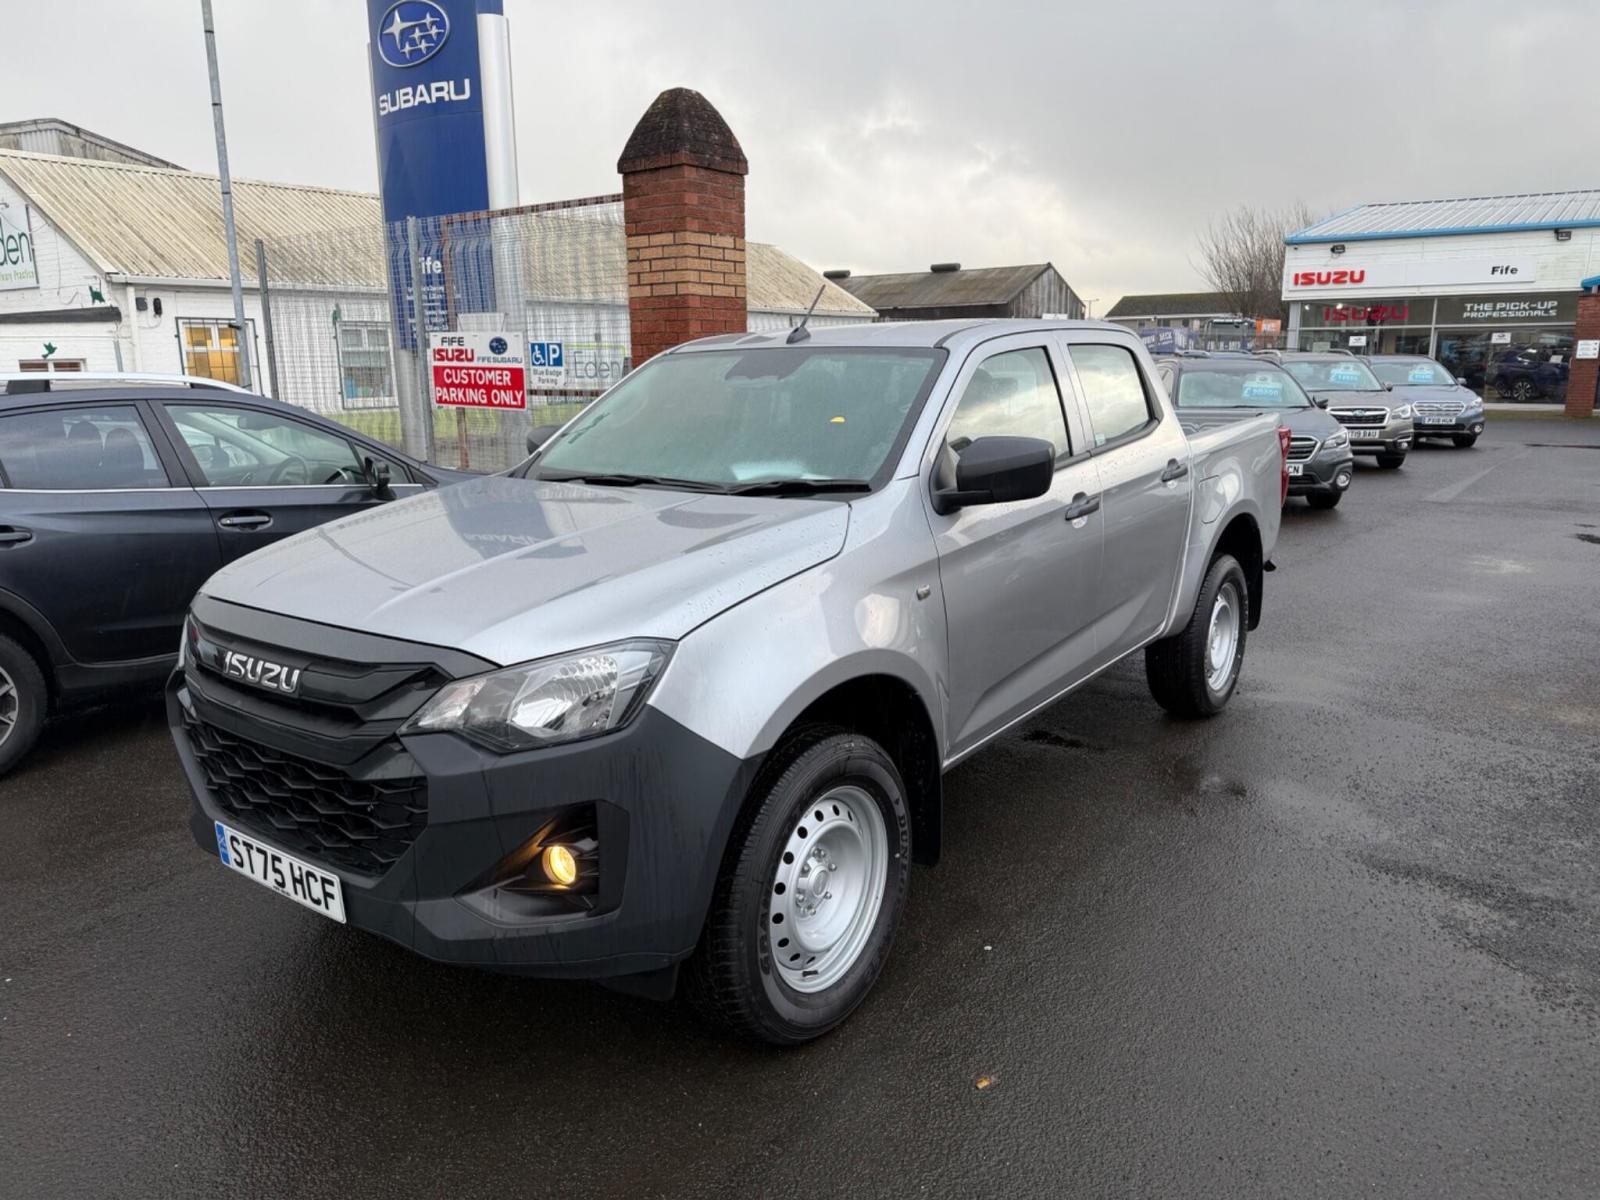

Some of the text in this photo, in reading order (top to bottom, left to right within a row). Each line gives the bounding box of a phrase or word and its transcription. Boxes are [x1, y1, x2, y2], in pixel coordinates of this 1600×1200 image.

[379, 78, 471, 117] SUBARU
[419, 256, 443, 275] ife
[1491, 265, 1519, 276] Fife
[1293, 269, 1365, 287] ISUZU
[1323, 304, 1409, 322] ISUZU
[1462, 309, 1558, 319] PROFESSIONALS
[1464, 300, 1558, 312] THE PICK-UP
[441, 336, 465, 347] FIFE
[433, 348, 475, 363] ISUZU
[549, 344, 560, 365] P
[573, 350, 623, 379] Eden
[443, 369, 512, 386] CUSTOMER
[538, 377, 558, 385] Parking
[435, 387, 524, 406] PARKING ONLY
[224, 650, 300, 693] ISUZU
[229, 835, 336, 911] ST75 HCF
